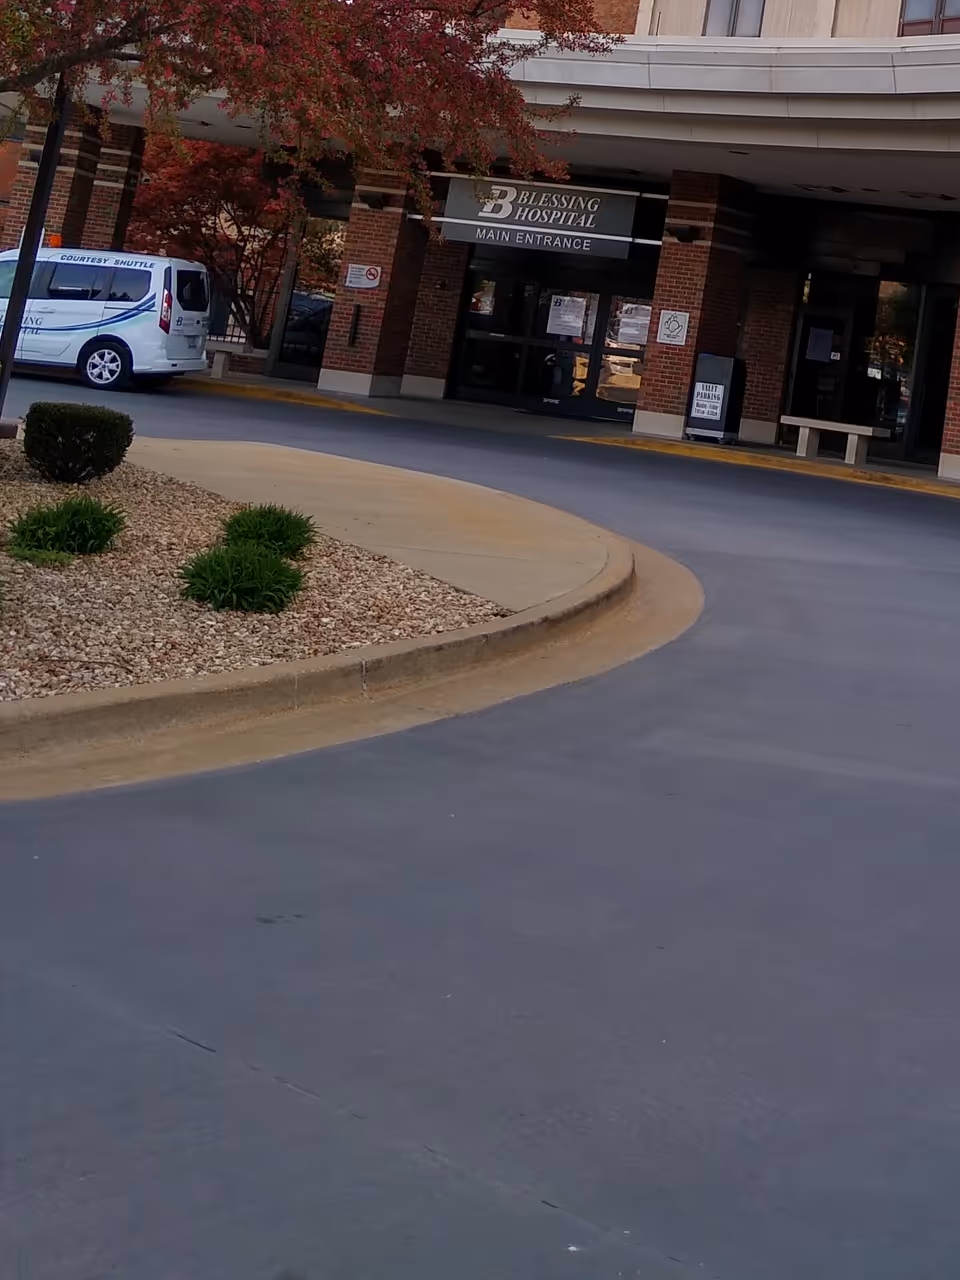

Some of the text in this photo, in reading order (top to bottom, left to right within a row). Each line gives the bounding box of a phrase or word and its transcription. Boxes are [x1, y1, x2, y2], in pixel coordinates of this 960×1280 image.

[517, 191, 600, 212] BLESSING
[514, 207, 597, 228] HOSPITAL
[476, 228, 591, 251] MAIN ENTRANCE
[60, 254, 156, 269] COURTESY SHUTTLE
[696, 391, 721, 400] PARKING
